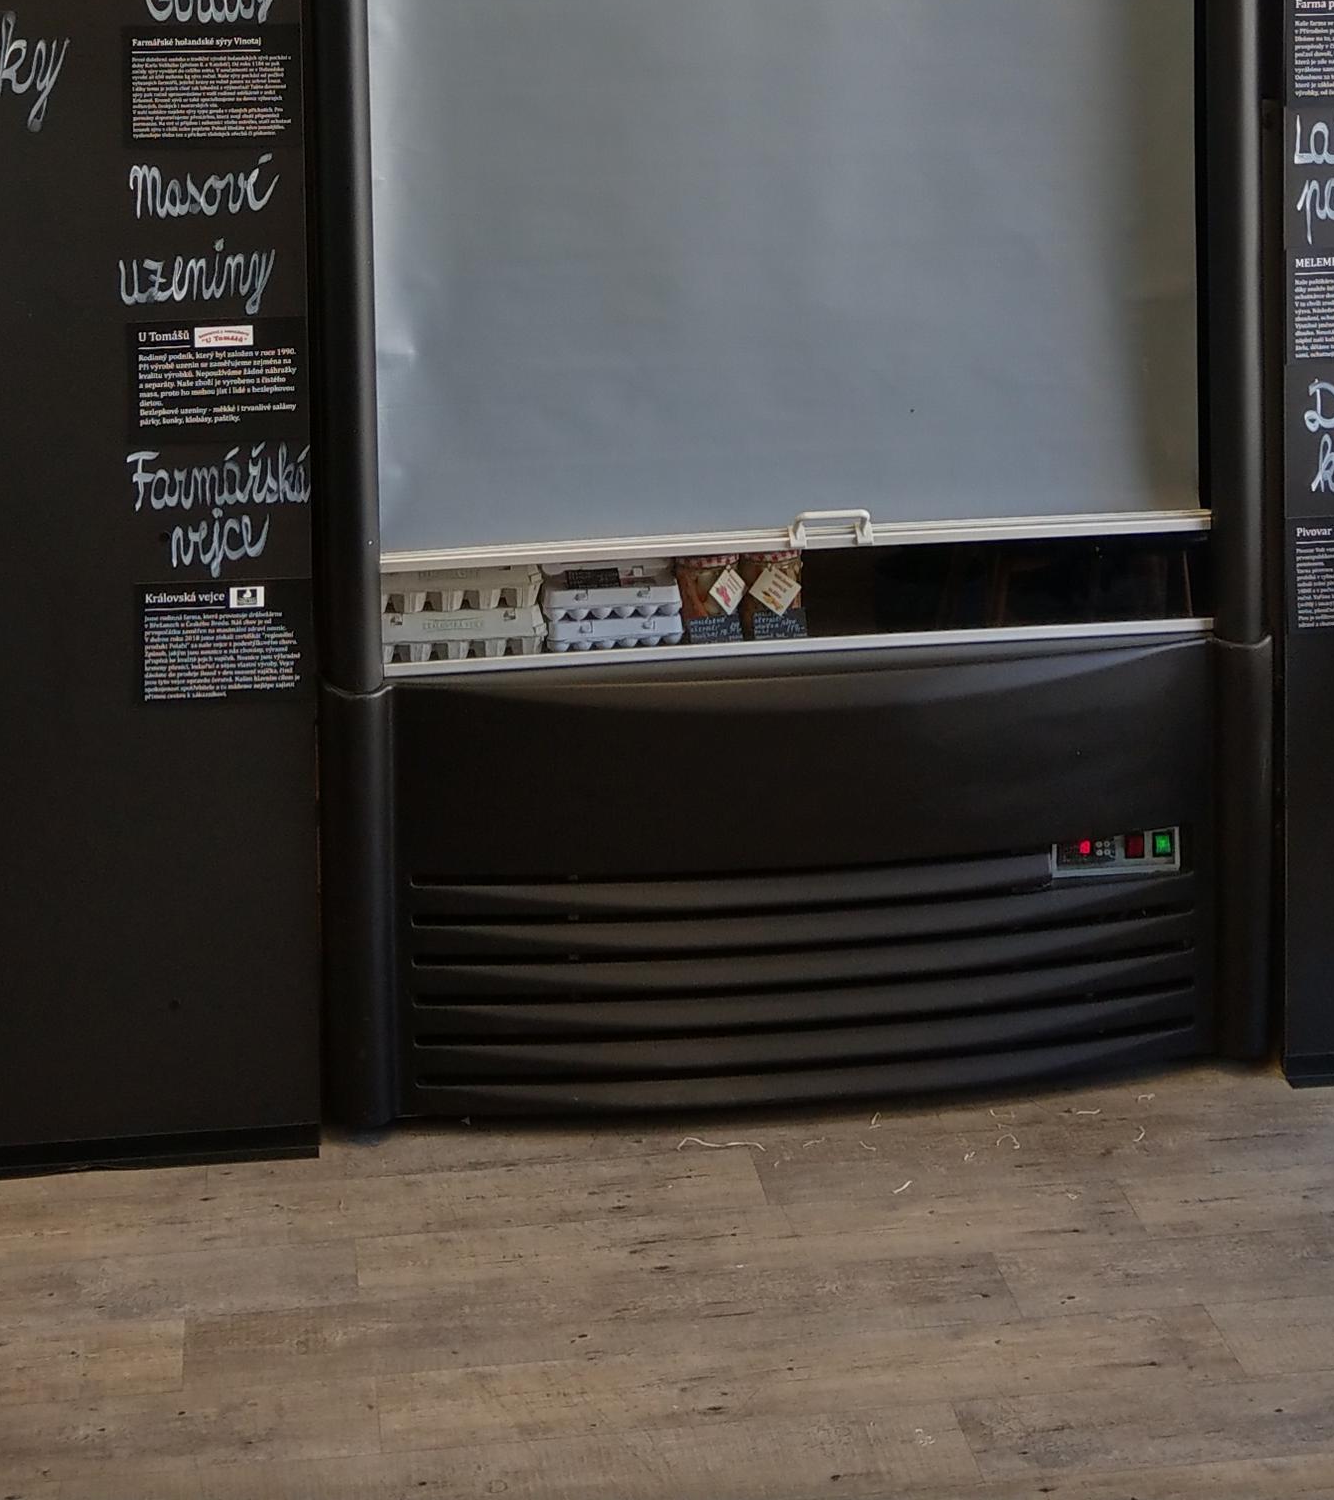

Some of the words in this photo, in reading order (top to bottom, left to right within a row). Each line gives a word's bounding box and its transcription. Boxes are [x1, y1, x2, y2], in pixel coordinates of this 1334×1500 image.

[1295, 0, 1326, 9] Farma
[132, 38, 173, 46] Farmářské
[175, 37, 214, 46] holandské
[138, 331, 148, 342] U
[151, 329, 190, 341] Tomášů
[1296, 527, 1332, 538] Pivovar
[145, 592, 196, 604] Královská
[199, 592, 225, 603] vejce
